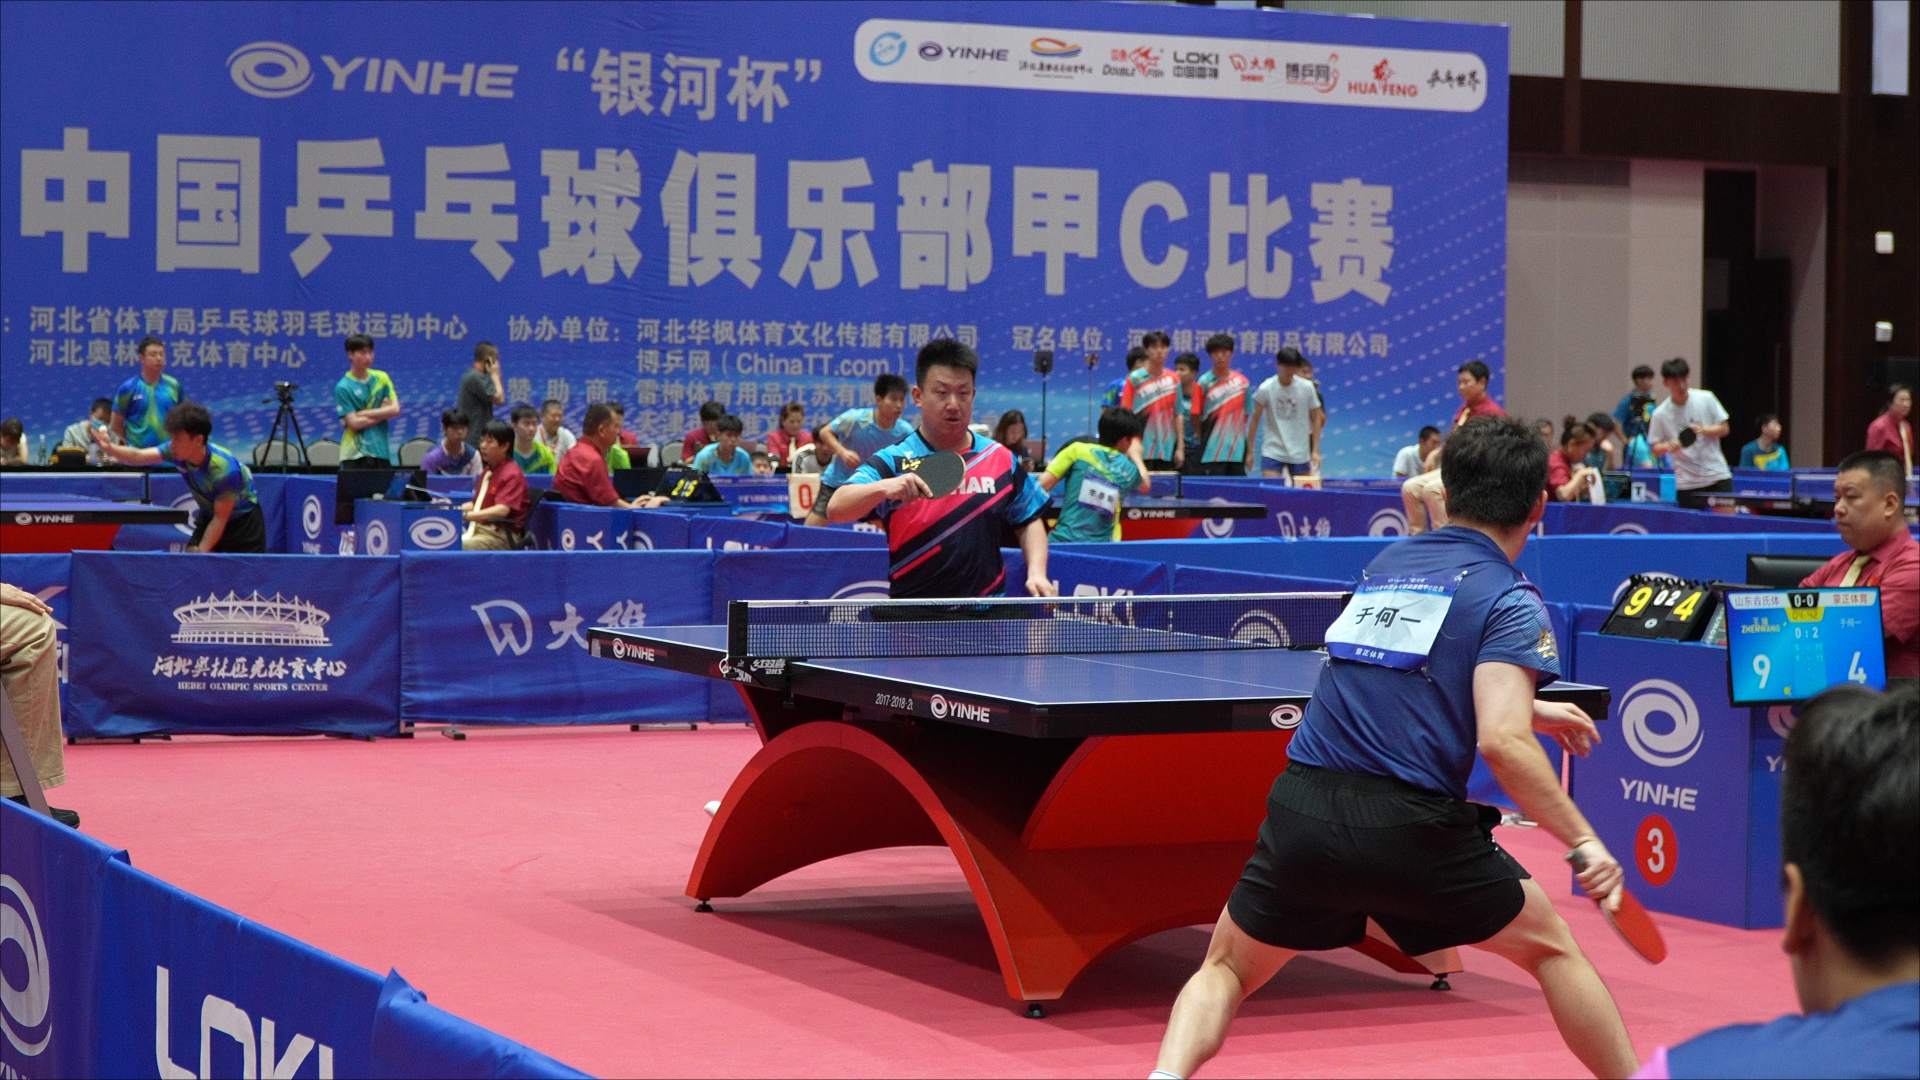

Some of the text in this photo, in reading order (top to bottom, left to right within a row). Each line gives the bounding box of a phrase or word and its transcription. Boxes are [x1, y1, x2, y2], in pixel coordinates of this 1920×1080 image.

[947, 47, 1008, 61] YINHE
[1173, 52, 1219, 65] LOKI
[321, 55, 519, 99] YINHE
[1102, 64, 1136, 77] DOUBLE
[1348, 80, 1419, 97] HUA FENG
[20, 127, 1395, 305] 中国乒乓球俱乐部甲C比赛
[30, 306, 468, 340] 河北省体育局乒乓球羽毛球运动中心
[29, 339, 307, 368] 河北奥林克体育中心
[34, 514, 74, 524] YINHE
[1143, 510, 1176, 518] YINHE
[1624, 586, 1653, 616] 9
[1673, 591, 1702, 621] 4
[1794, 594, 1814, 607] 0-0
[1356, 606, 1421, 628] 于何一
[625, 643, 655, 662] YINHE
[1752, 654, 1771, 689] 9
[1848, 651, 1867, 684] 4
[178, 682, 328, 692] HEBEI OLYMPIC SPORTS CENTER
[948, 701, 991, 723] YINHE
[1620, 778, 1698, 811] YINHE
[1647, 828, 1665, 874] 3
